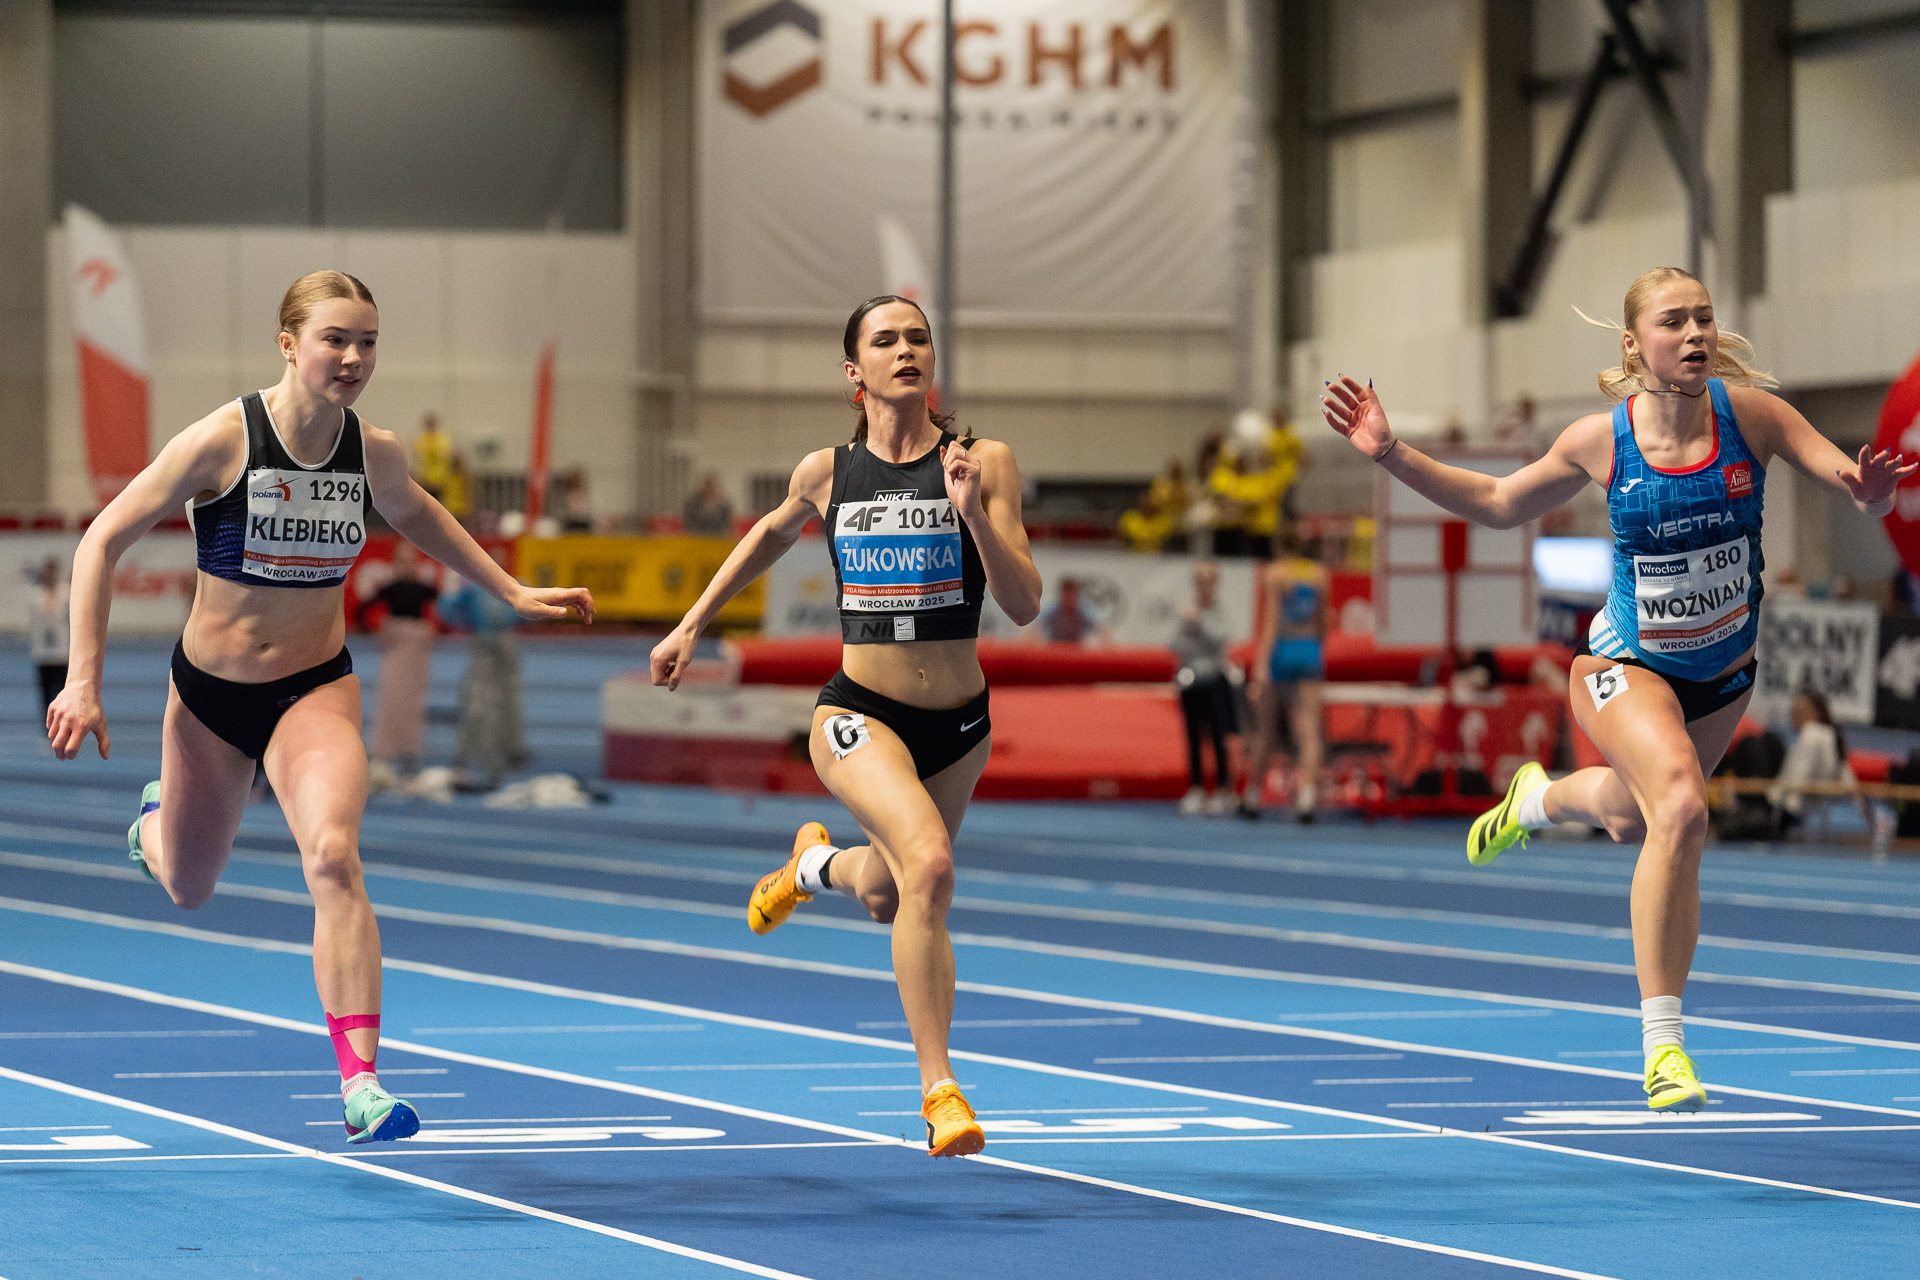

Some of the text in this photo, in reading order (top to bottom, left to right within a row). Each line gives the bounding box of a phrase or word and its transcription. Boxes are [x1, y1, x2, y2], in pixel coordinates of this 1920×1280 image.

[870, 17, 1175, 91] KGHM
[252, 489, 284, 500] polanik
[309, 479, 361, 503] 1296
[876, 492, 914, 502] NIKE
[250, 515, 362, 545] KLEBIEKO
[897, 506, 956, 529] 1014
[1646, 510, 1735, 539] VECTRA
[841, 541, 956, 572] ŻUKOWSKA
[1640, 562, 1686, 574] Wrocław
[1702, 545, 1741, 574] 180
[262, 565, 339, 579] WROCŁAW 2025
[858, 596, 945, 609] WROCŁAW 2025
[877, 587, 914, 595] Mistrzostwa
[1641, 576, 1745, 620] WOŹNIAK
[1659, 623, 1738, 650] WROCŁAW 2025
[1594, 667, 1618, 700] 5
[832, 714, 859, 749] 6
